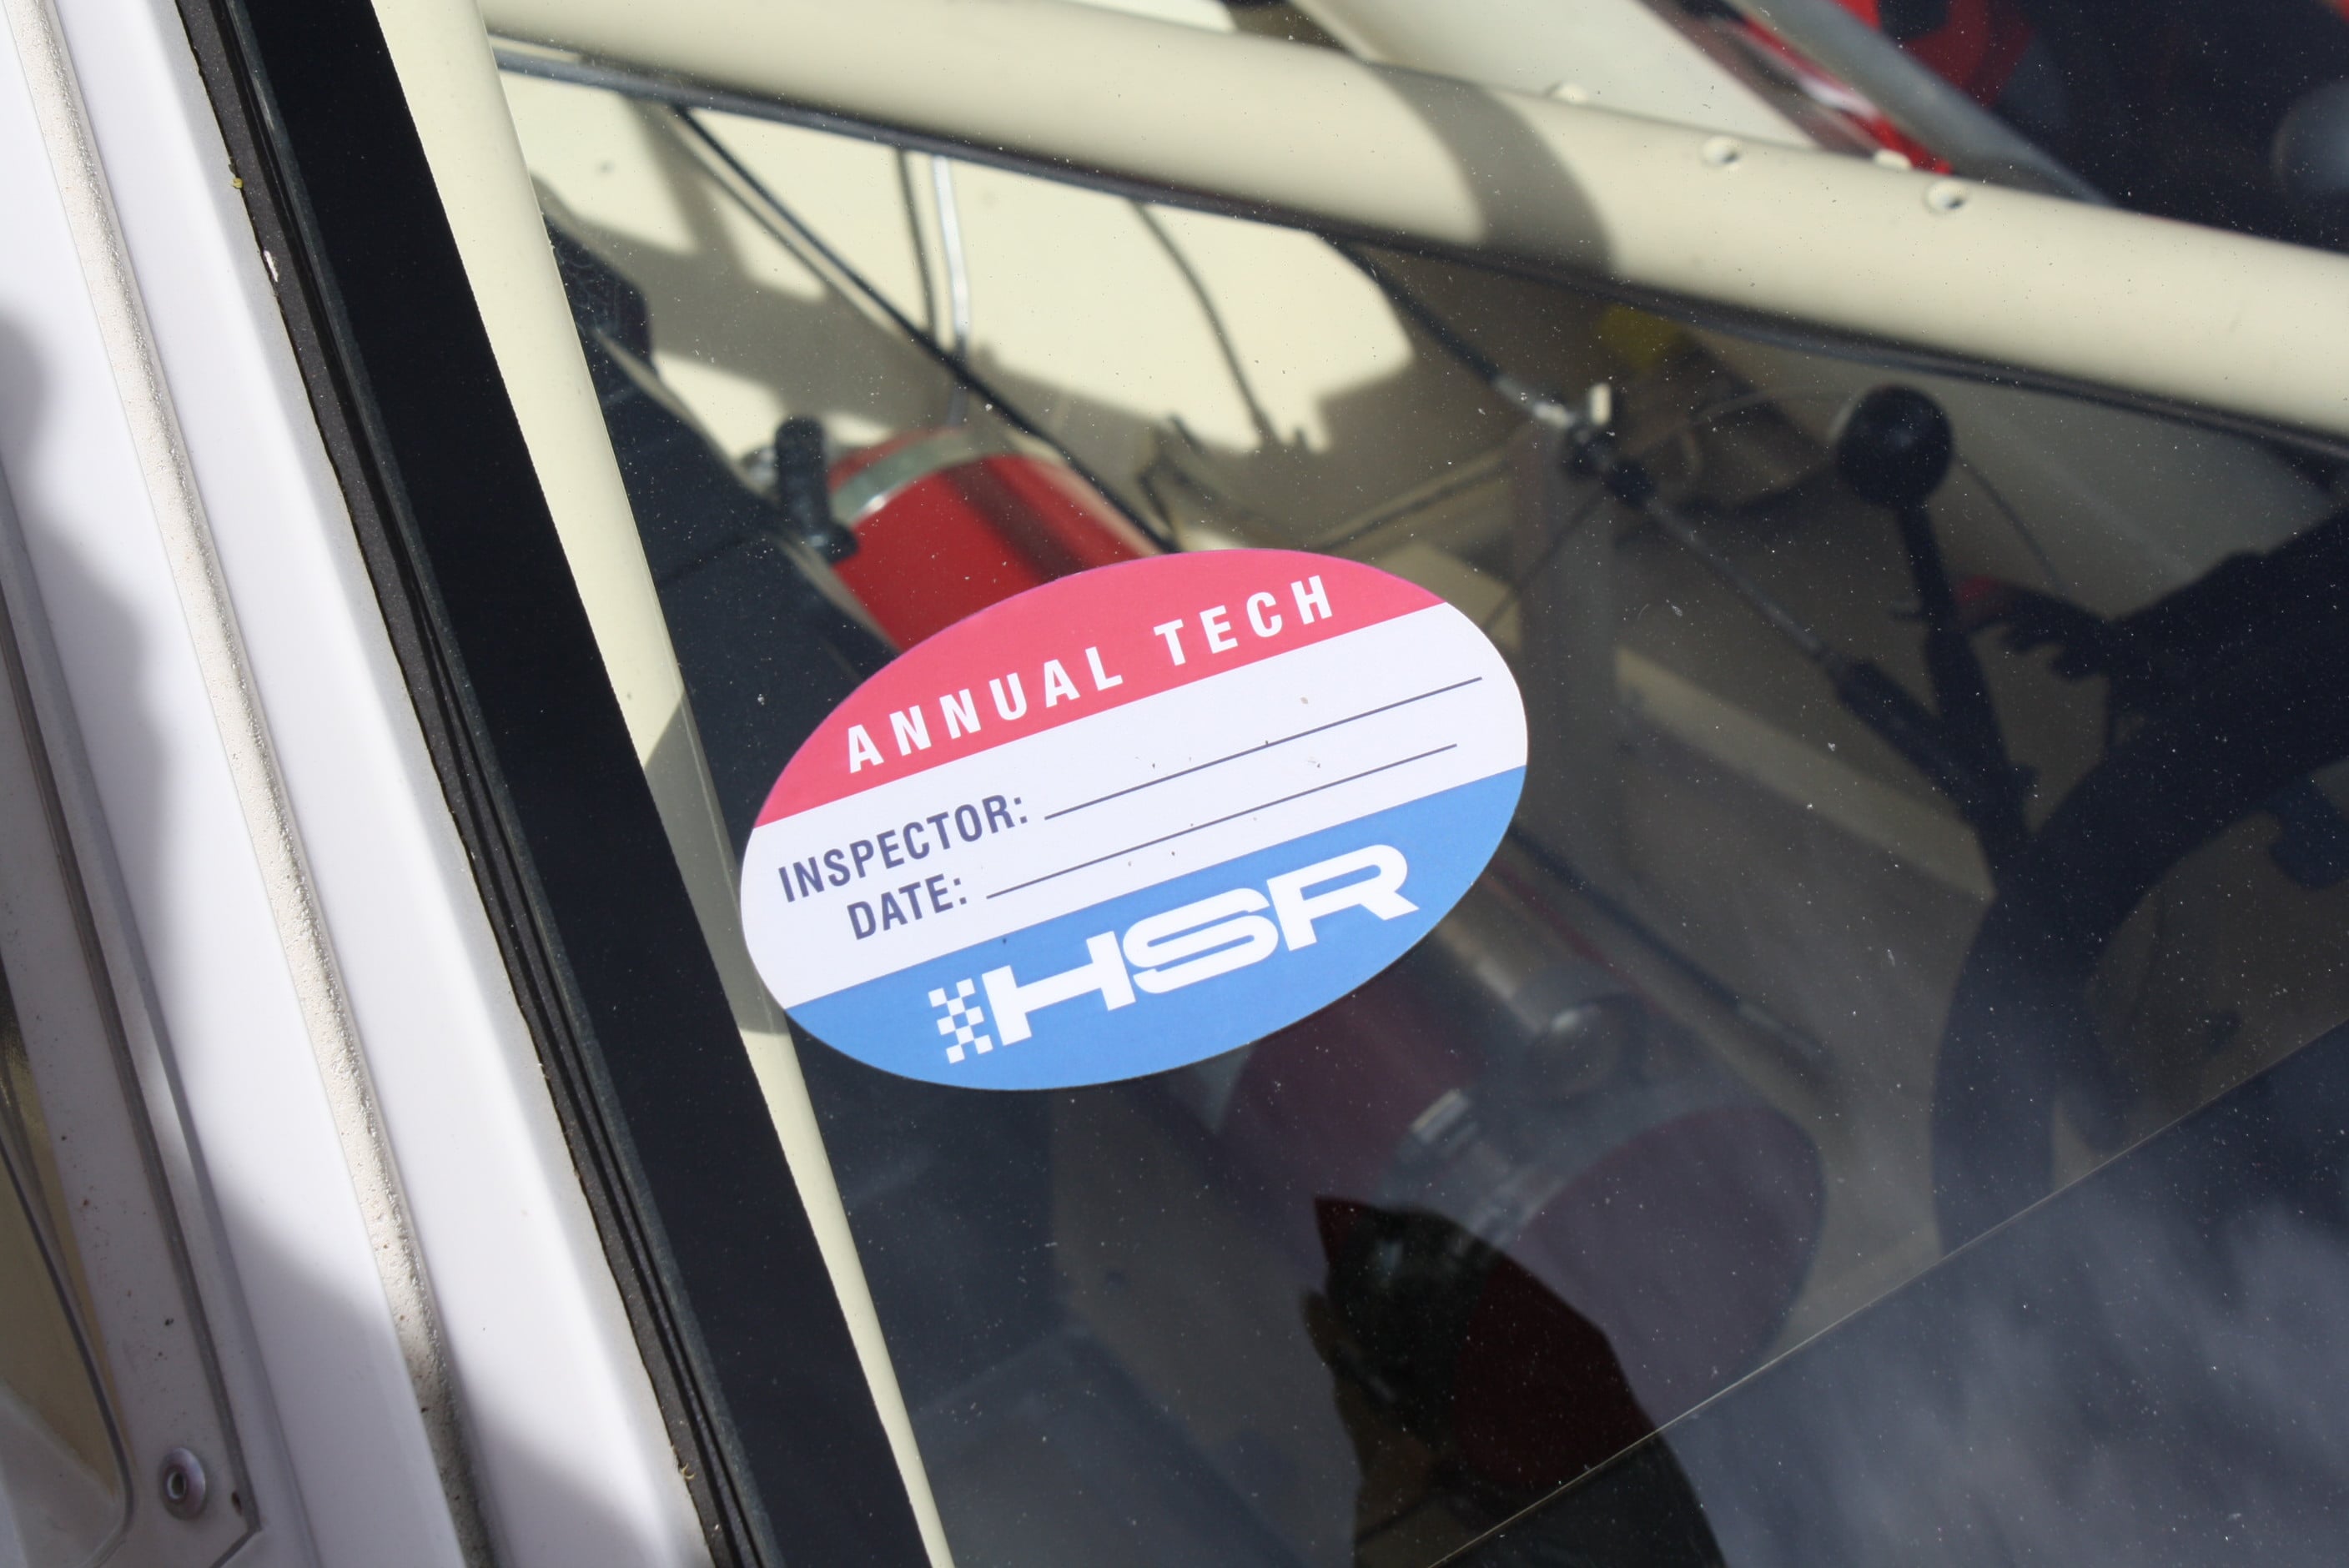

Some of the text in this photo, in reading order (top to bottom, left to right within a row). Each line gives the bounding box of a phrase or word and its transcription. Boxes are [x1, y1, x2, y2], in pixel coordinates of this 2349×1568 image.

[846, 575, 1334, 773] ANNUAL TECH
[778, 793, 1029, 902] INSPECTOR:
[848, 873, 967, 941] DATE:
[982, 844, 1419, 1047] HSR
